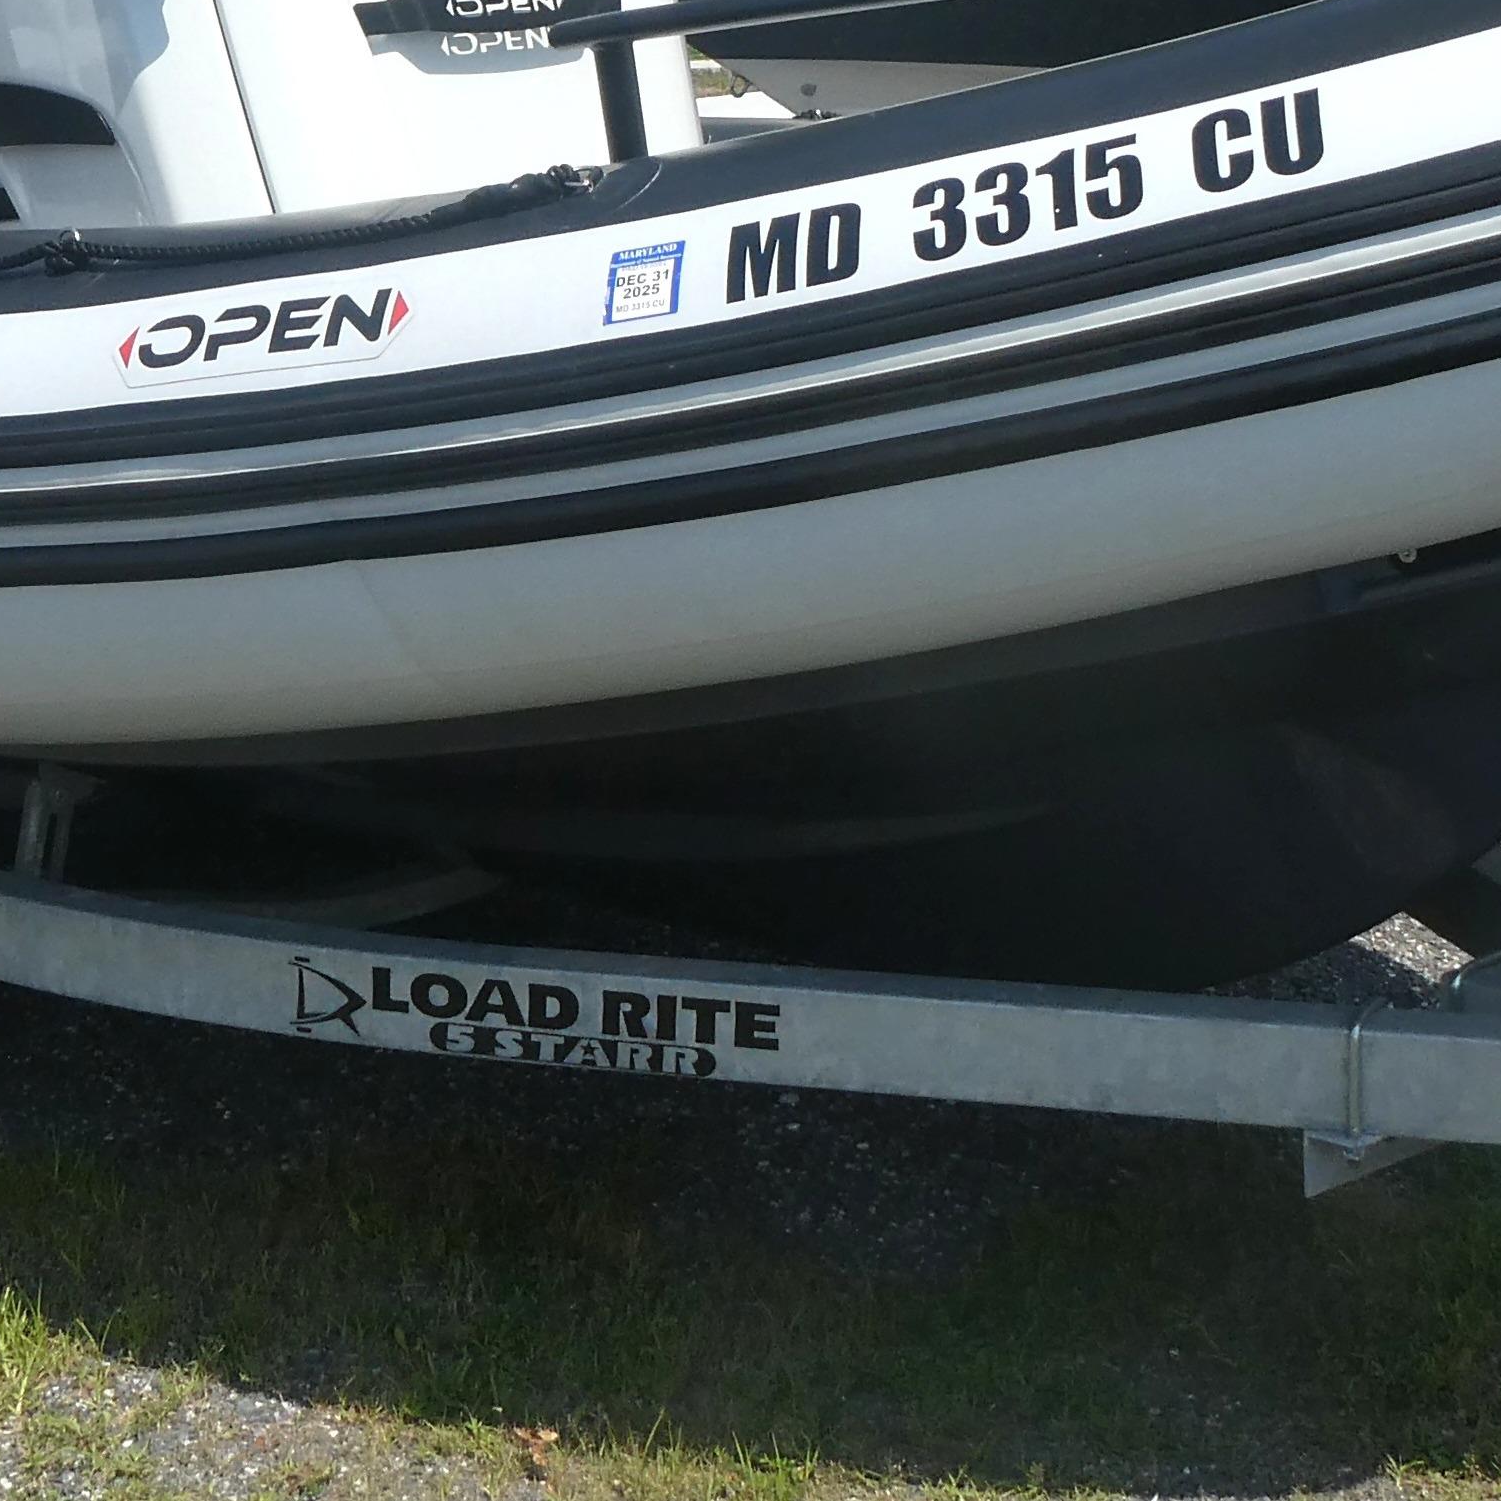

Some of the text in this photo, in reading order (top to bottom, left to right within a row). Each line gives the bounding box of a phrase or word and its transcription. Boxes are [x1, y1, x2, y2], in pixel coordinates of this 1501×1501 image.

[725, 87, 1326, 304] MD 3315 CU
[617, 243, 678, 261] MARYLAND
[616, 269, 669, 288] DEC 31
[623, 284, 660, 299] 2025
[616, 299, 665, 313] MD 3315 CU
[138, 287, 392, 369] OPEN
[371, 966, 781, 1051] LOAD RITE
[443, 1022, 702, 1077] 5 STARR
